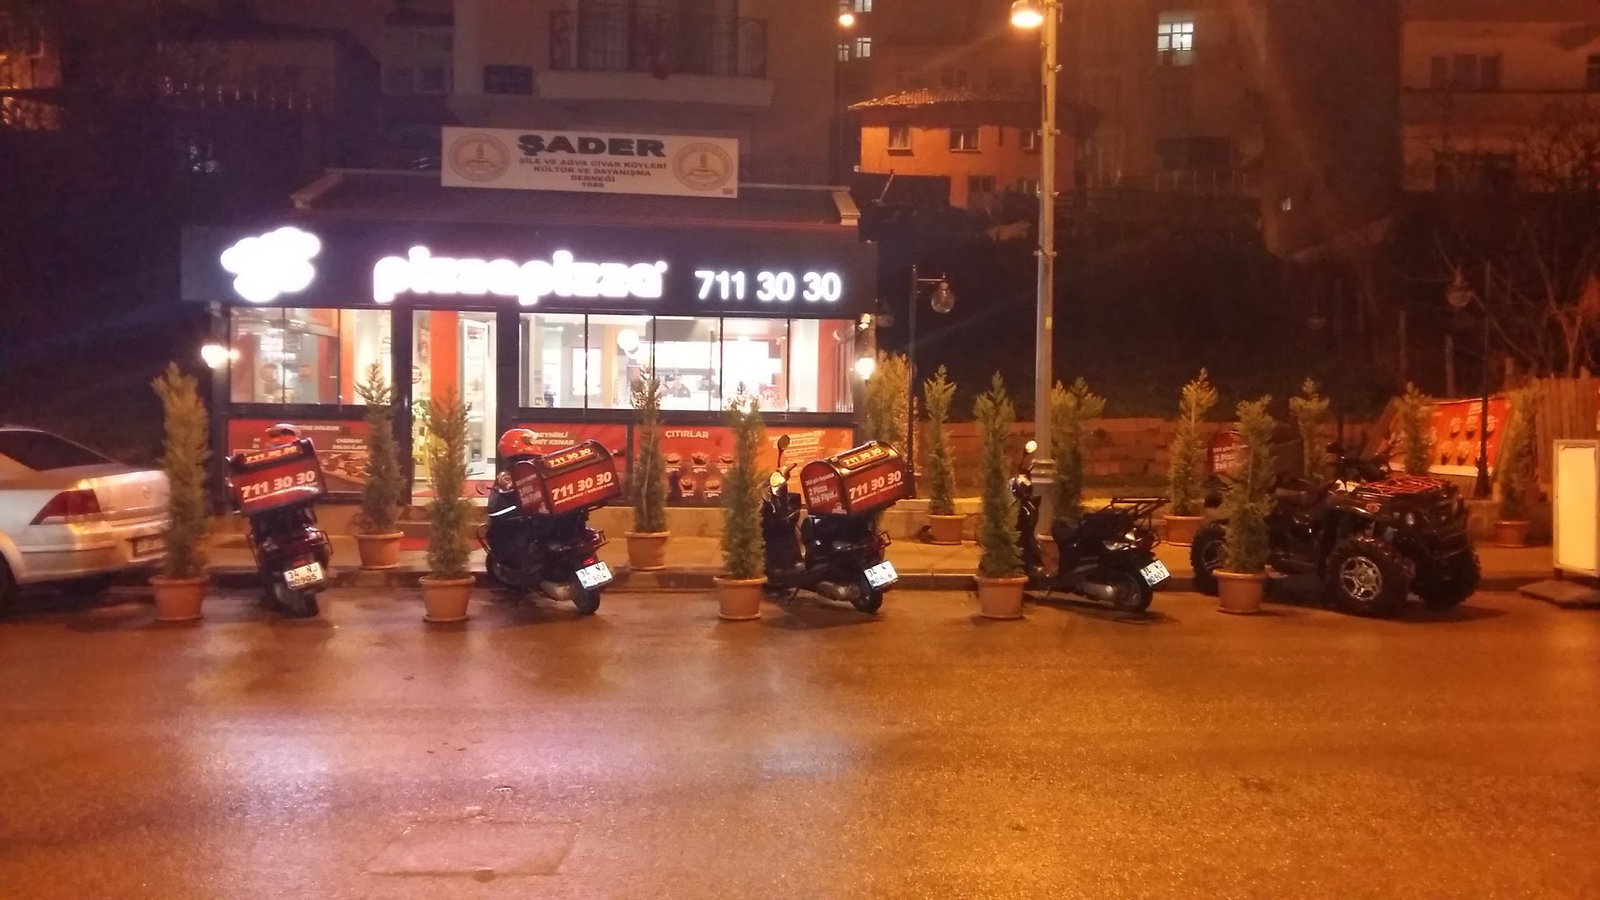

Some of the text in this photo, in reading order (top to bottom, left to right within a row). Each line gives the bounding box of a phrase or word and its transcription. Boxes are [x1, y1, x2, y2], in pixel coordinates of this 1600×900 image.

[517, 134, 667, 158] ŞADER
[533, 165, 574, 173] KÜLTÜR
[594, 168, 651, 177] DAYANIŞMA
[694, 270, 841, 301] 711 30 30
[665, 430, 709, 439] ÇITIRLAR
[241, 480, 269, 499] 711
[273, 475, 293, 491] 30
[296, 470, 315, 486] 30
[551, 483, 574, 500] 711
[577, 477, 594, 492] 30
[596, 471, 612, 486] 30
[848, 482, 868, 499] 711
[871, 476, 885, 490] 30
[887, 470, 902, 485] 30
[287, 570, 300, 579] 34
